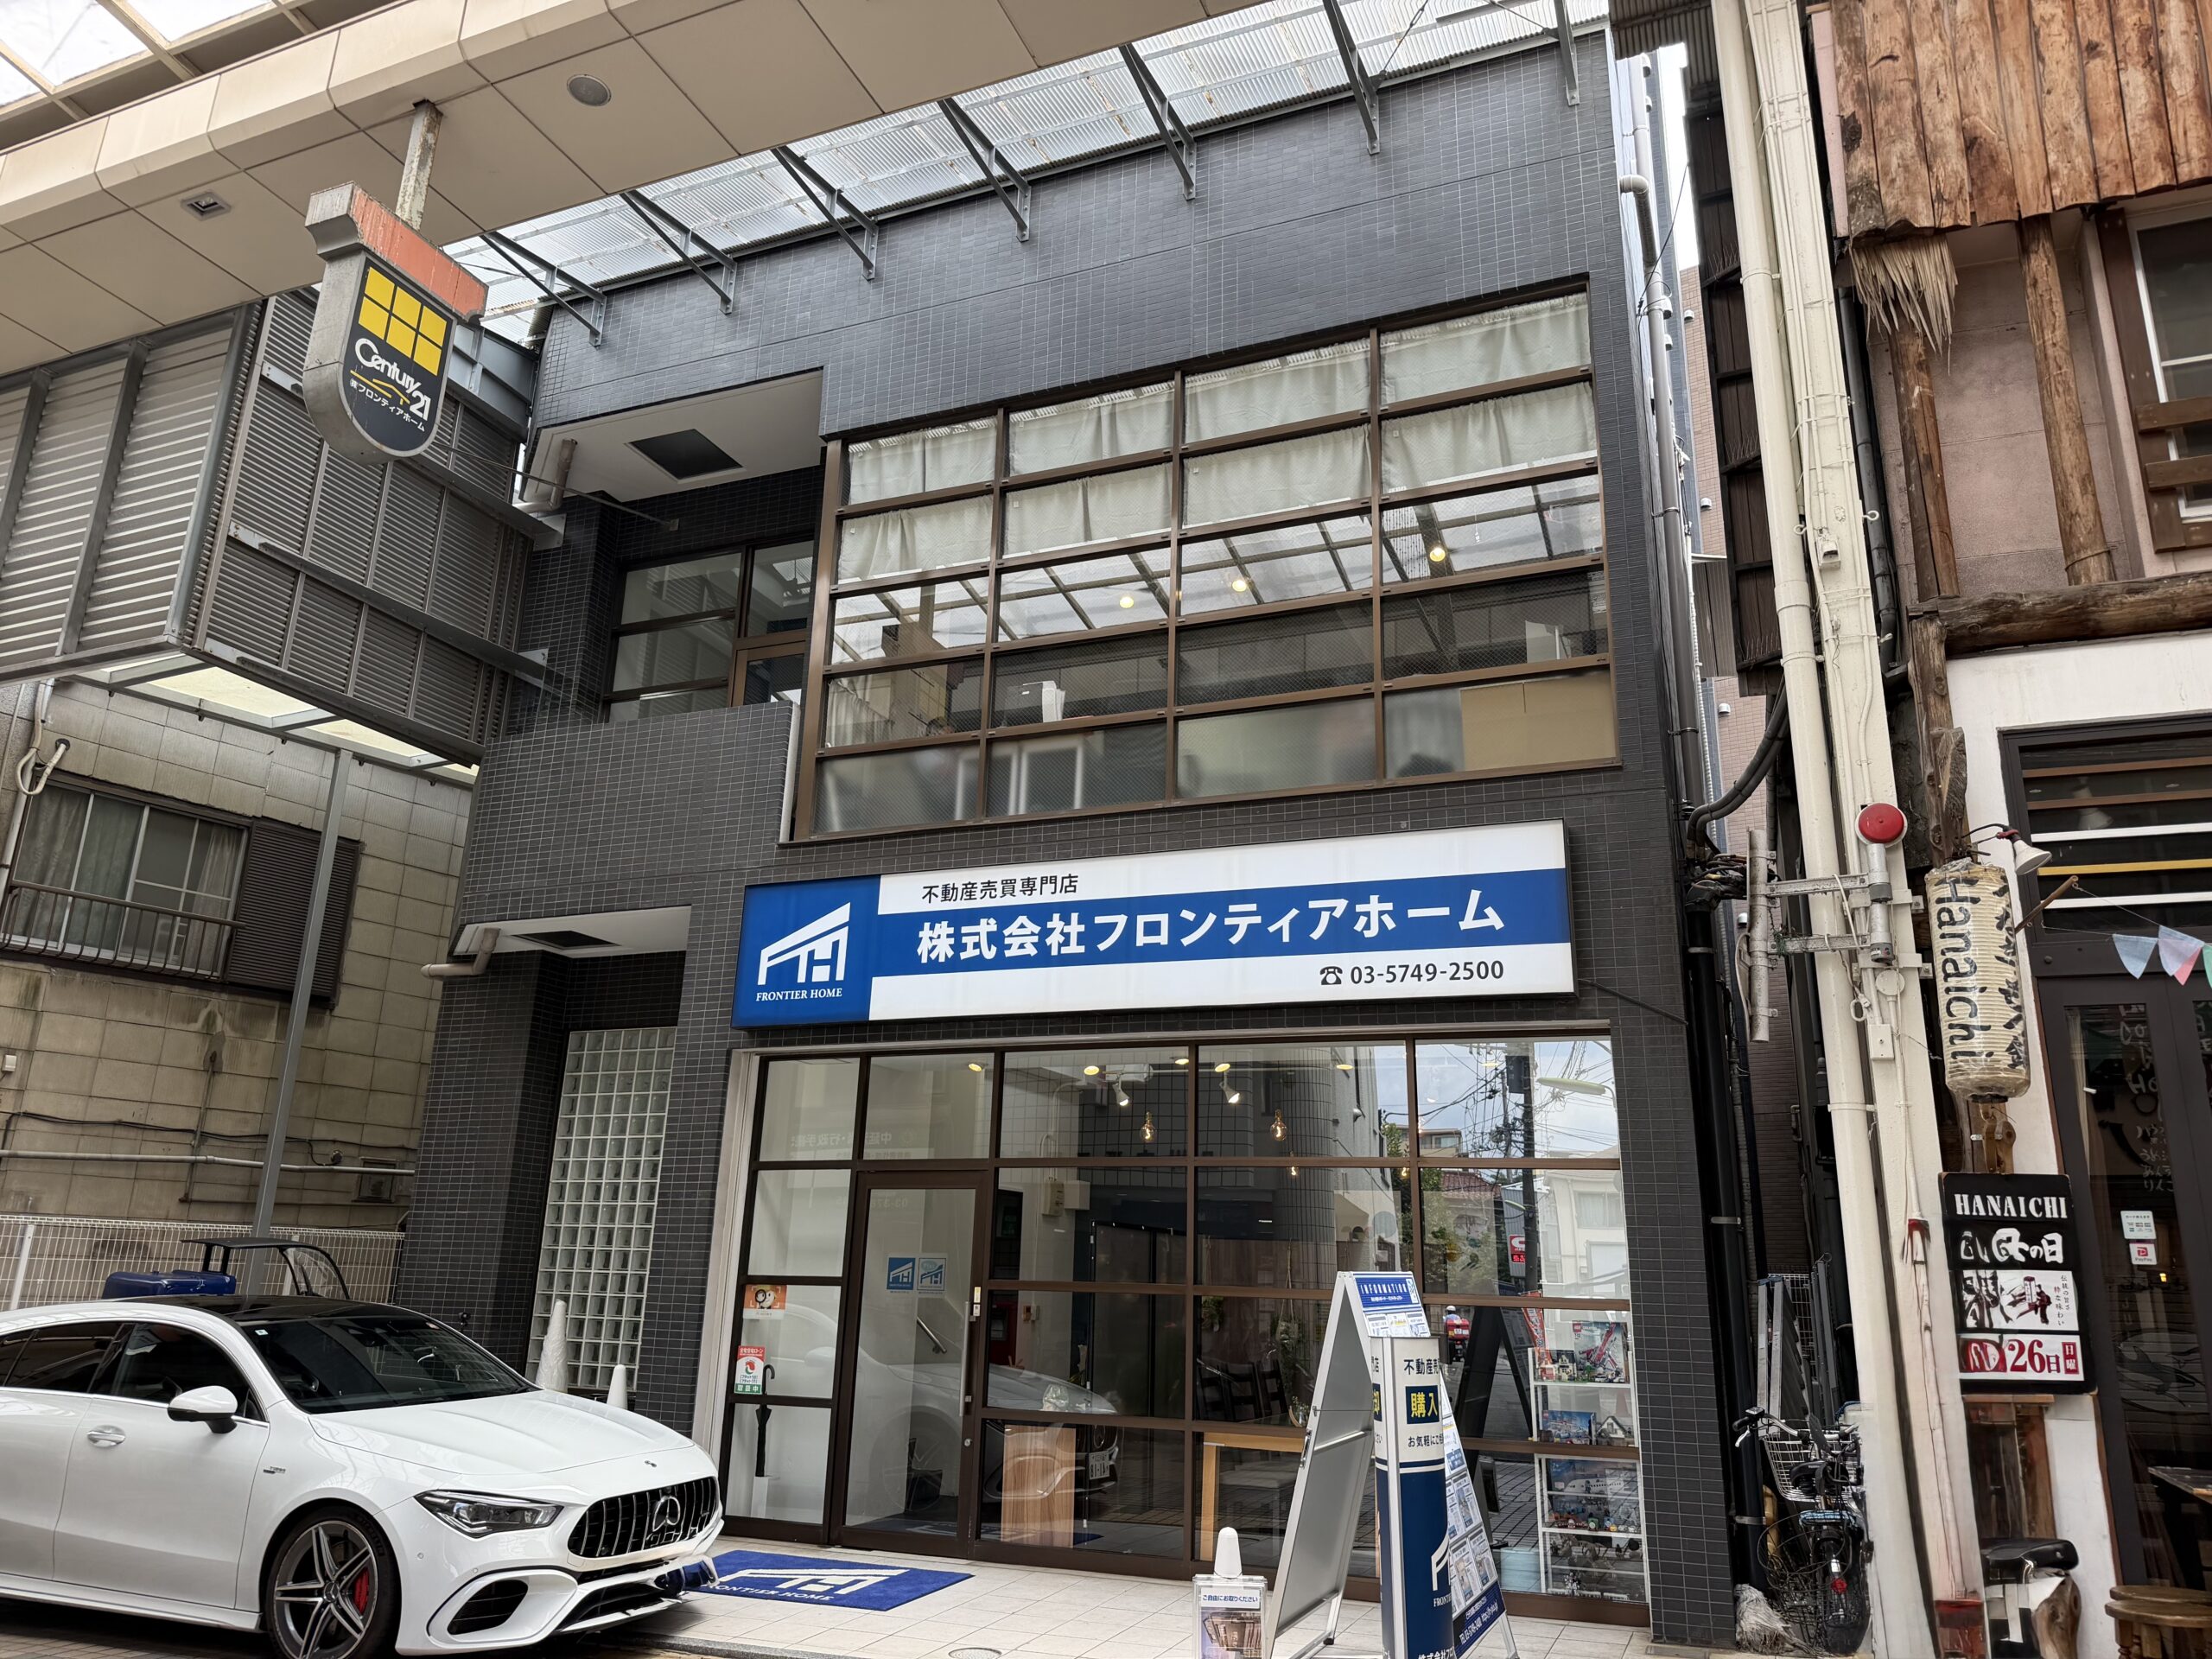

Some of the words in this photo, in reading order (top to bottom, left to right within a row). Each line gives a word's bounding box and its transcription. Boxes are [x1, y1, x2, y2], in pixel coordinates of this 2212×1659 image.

[410, 391, 431, 421] 21
[921, 874, 1078, 904] 不動産売買専門店
[917, 889, 1505, 963] 株式会社フロンティアホーム
[1350, 960, 1504, 985] 03-5749-2500
[756, 989, 808, 1001] FRONTIER
[810, 988, 842, 999] HOME
[1954, 1193, 2068, 1218] HANAICHI
[1360, 1283, 1408, 1294] INFORMATION
[1410, 1391, 1438, 1418] 購入
[779, 1592, 835, 1602] HOME
